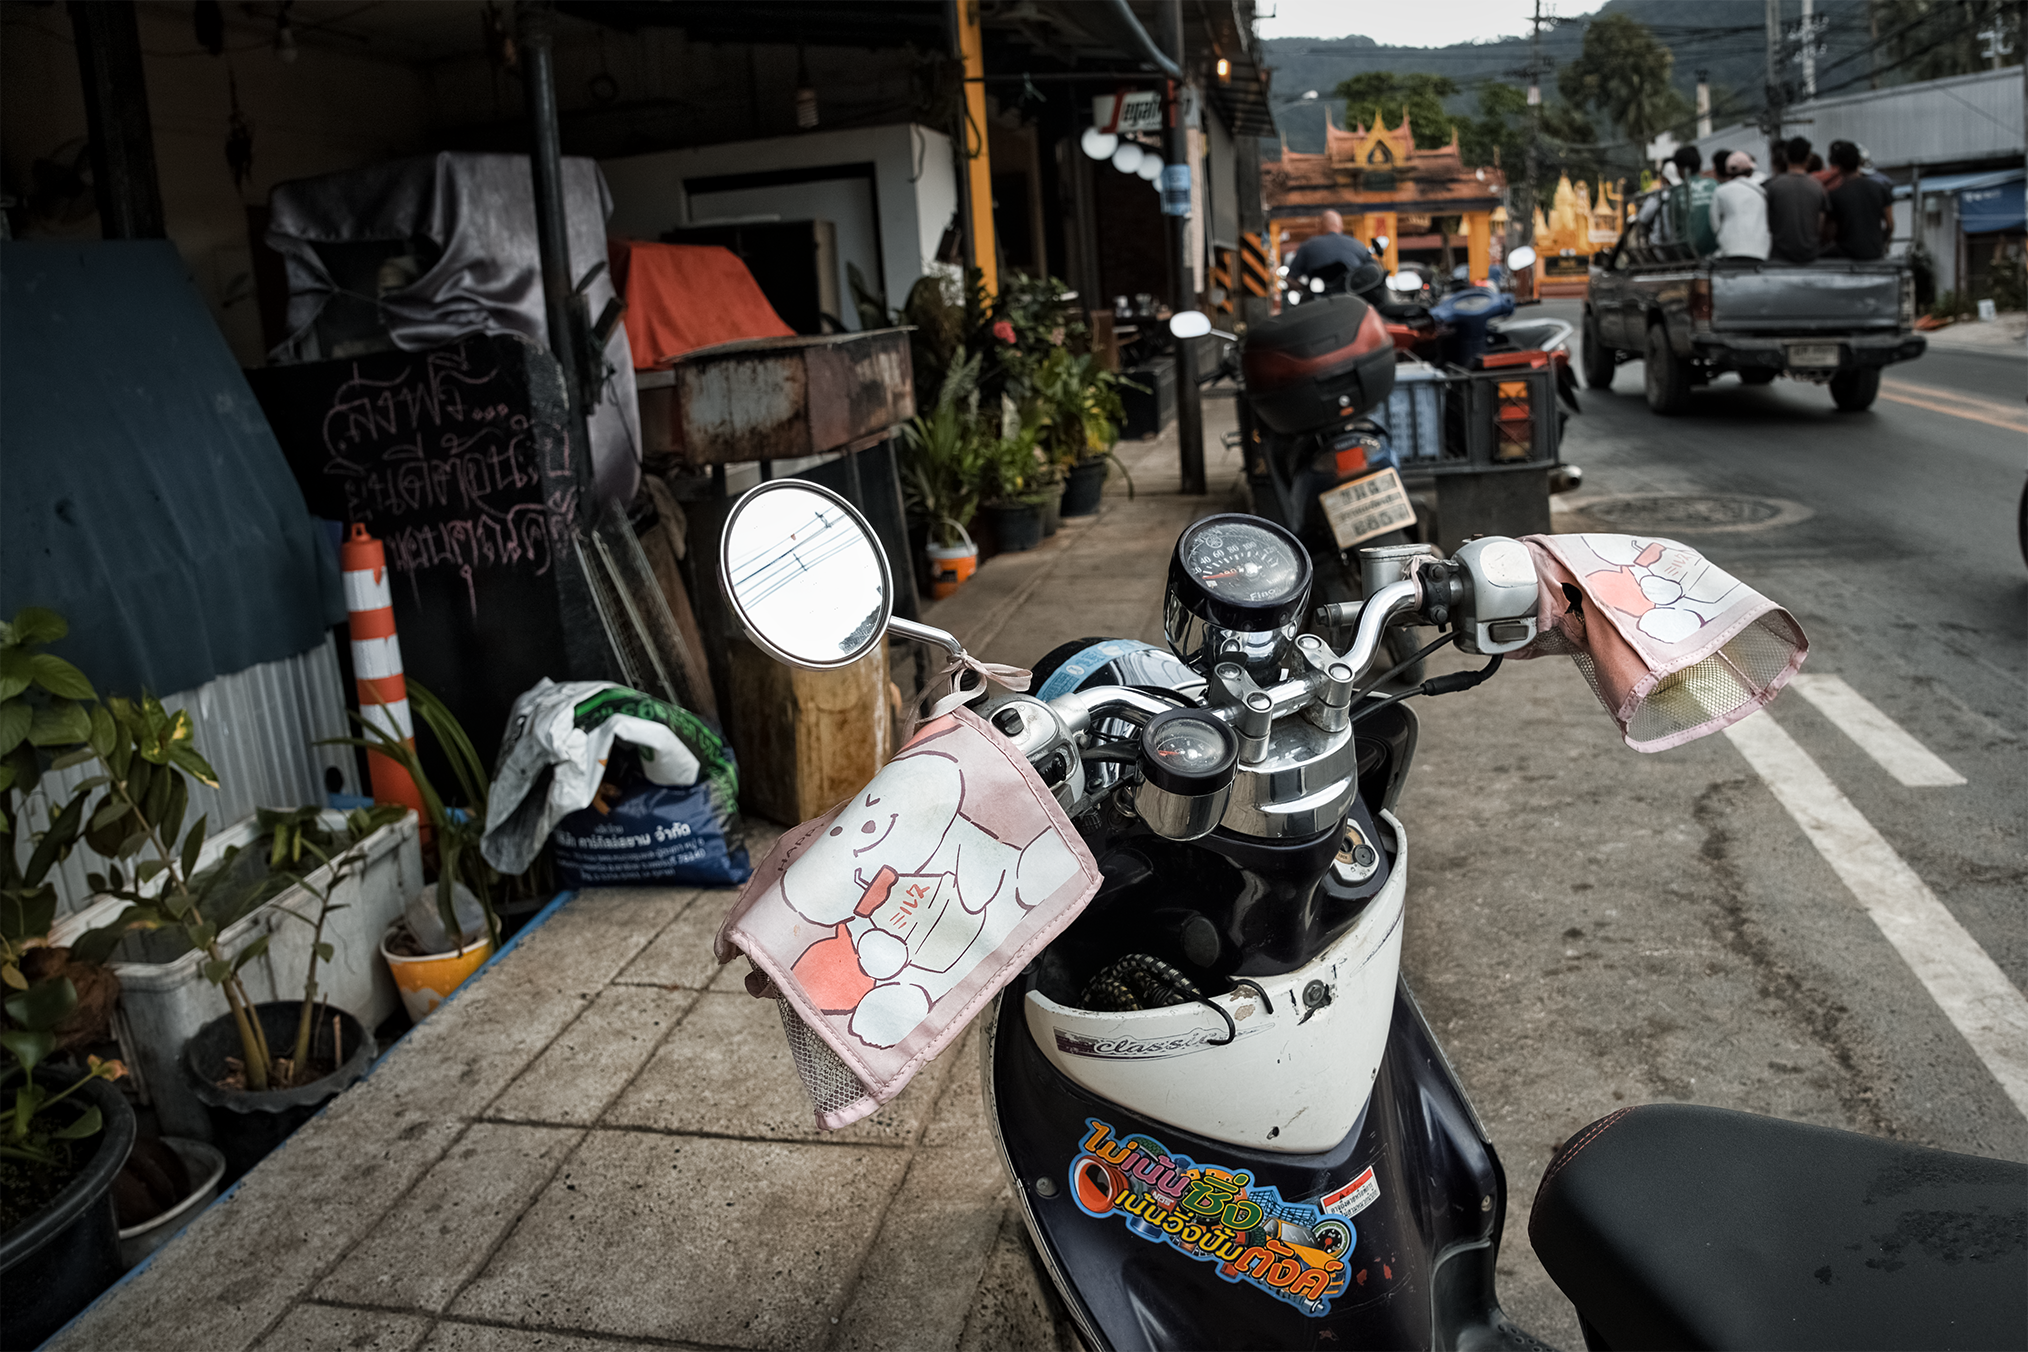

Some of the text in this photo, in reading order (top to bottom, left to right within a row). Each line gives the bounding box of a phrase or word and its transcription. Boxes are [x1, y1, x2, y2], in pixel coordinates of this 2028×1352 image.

[1200, 556, 1212, 565] 40
[1213, 549, 1225, 559] 60
[1226, 545, 1240, 554] 80
[1242, 541, 1257, 551] 100
